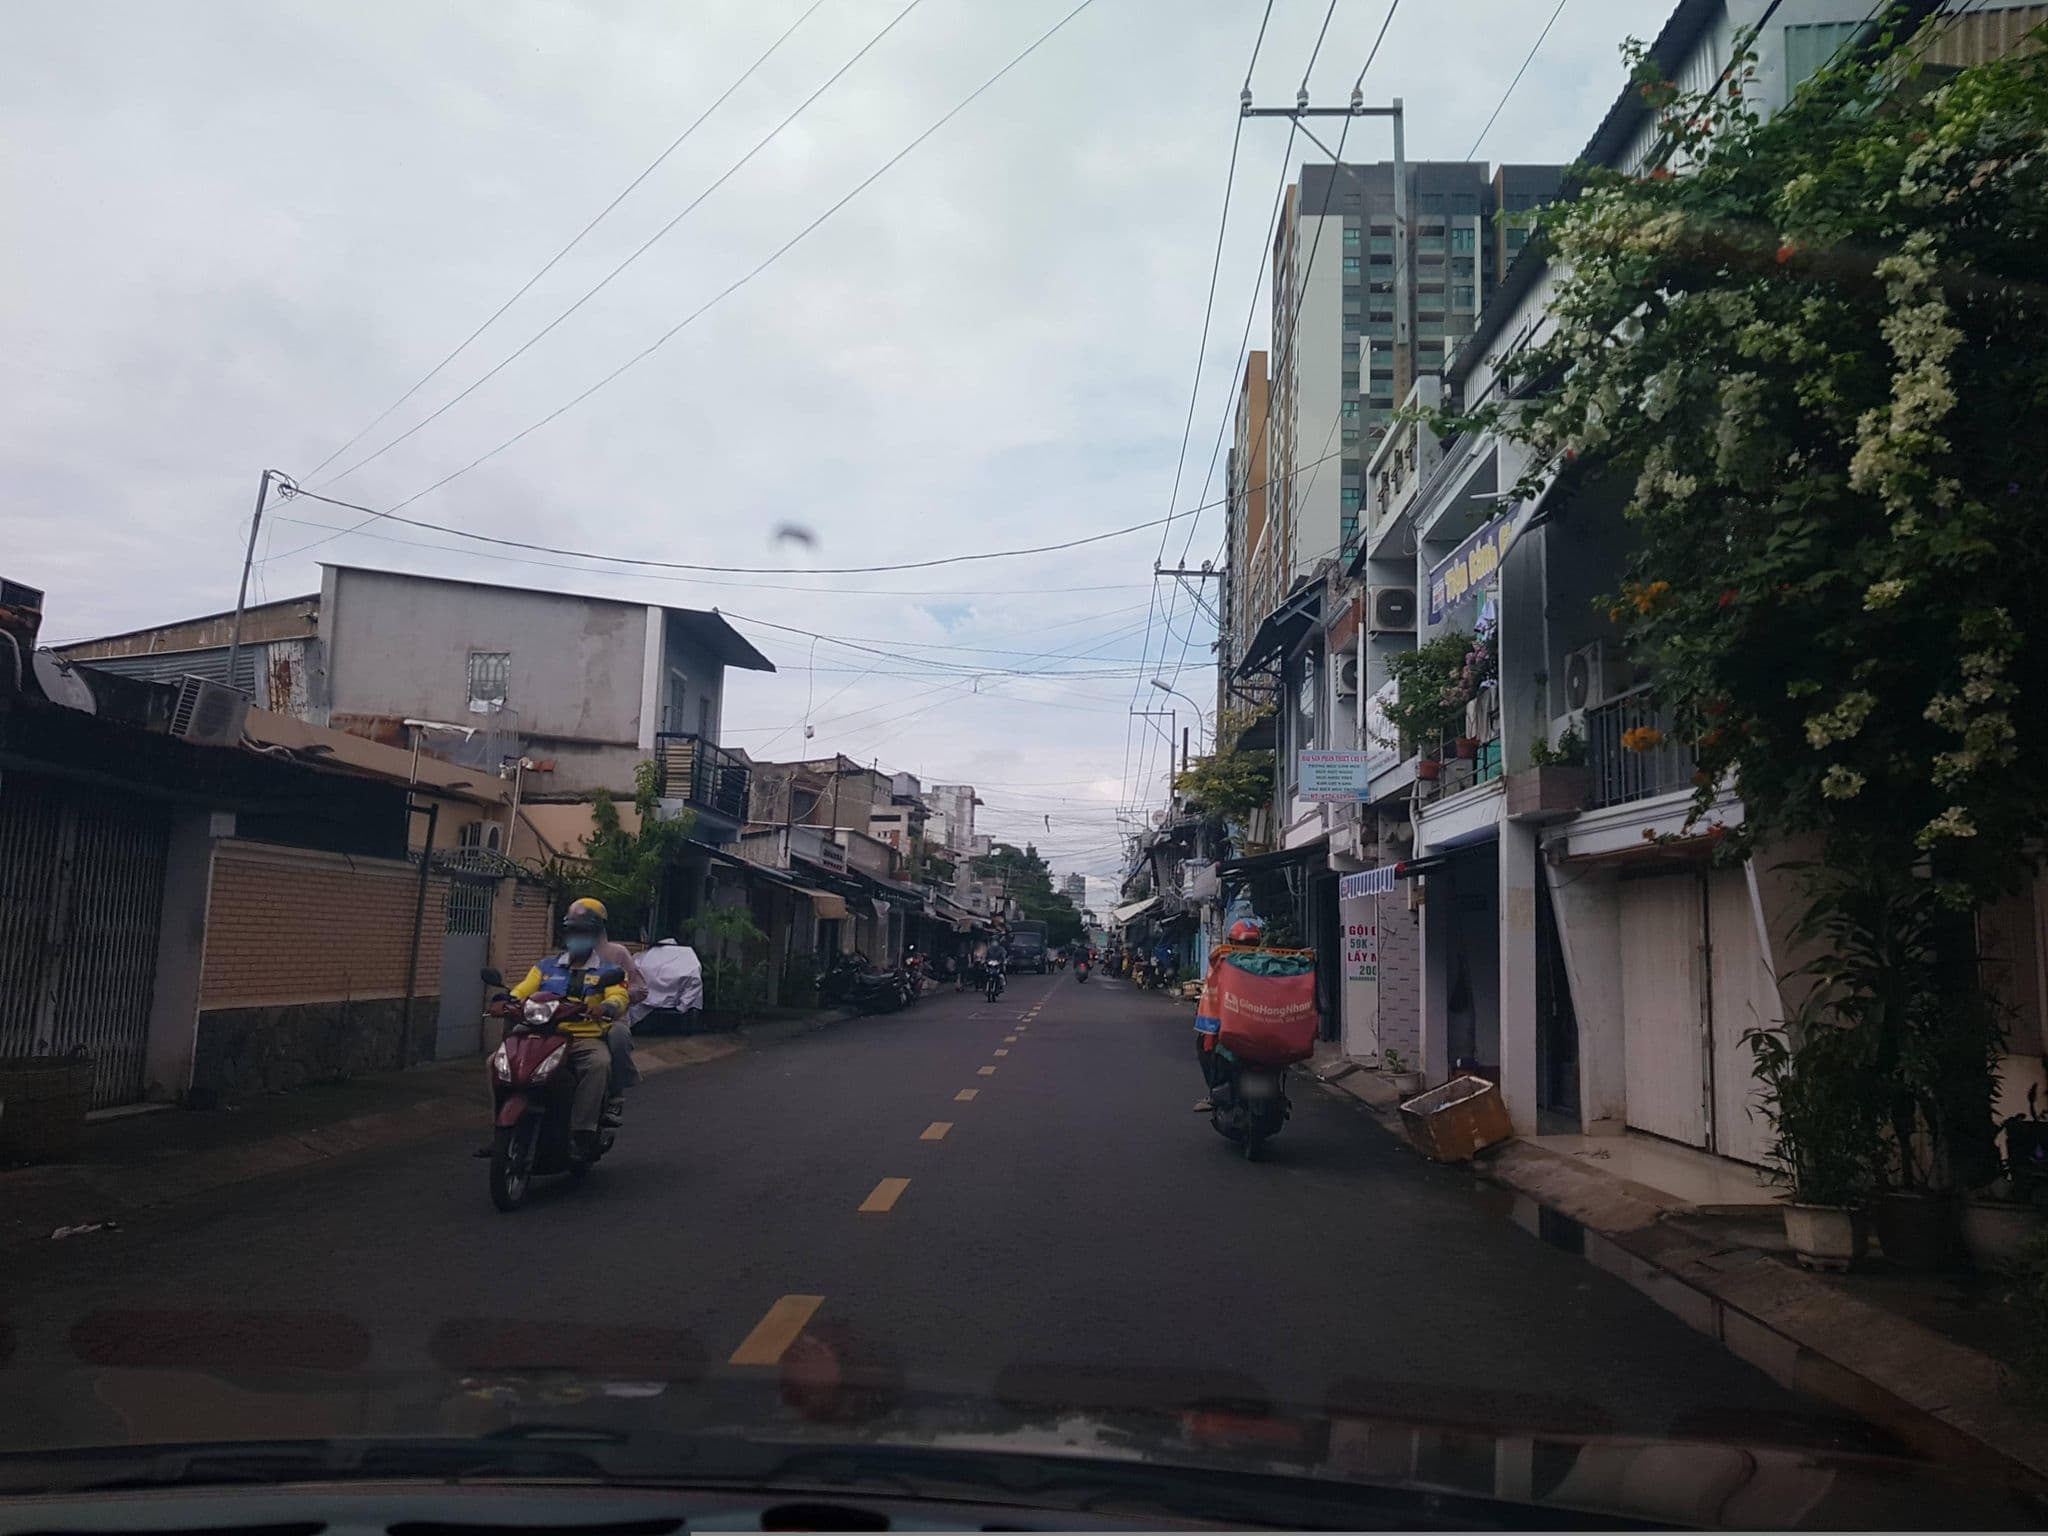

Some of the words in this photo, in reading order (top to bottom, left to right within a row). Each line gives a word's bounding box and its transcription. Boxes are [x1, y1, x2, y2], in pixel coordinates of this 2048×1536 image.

[1349, 924, 1368, 937] GỘI
[1348, 949, 1368, 962] LẤY
[1239, 999, 1312, 1017] GiaoHangNhan
